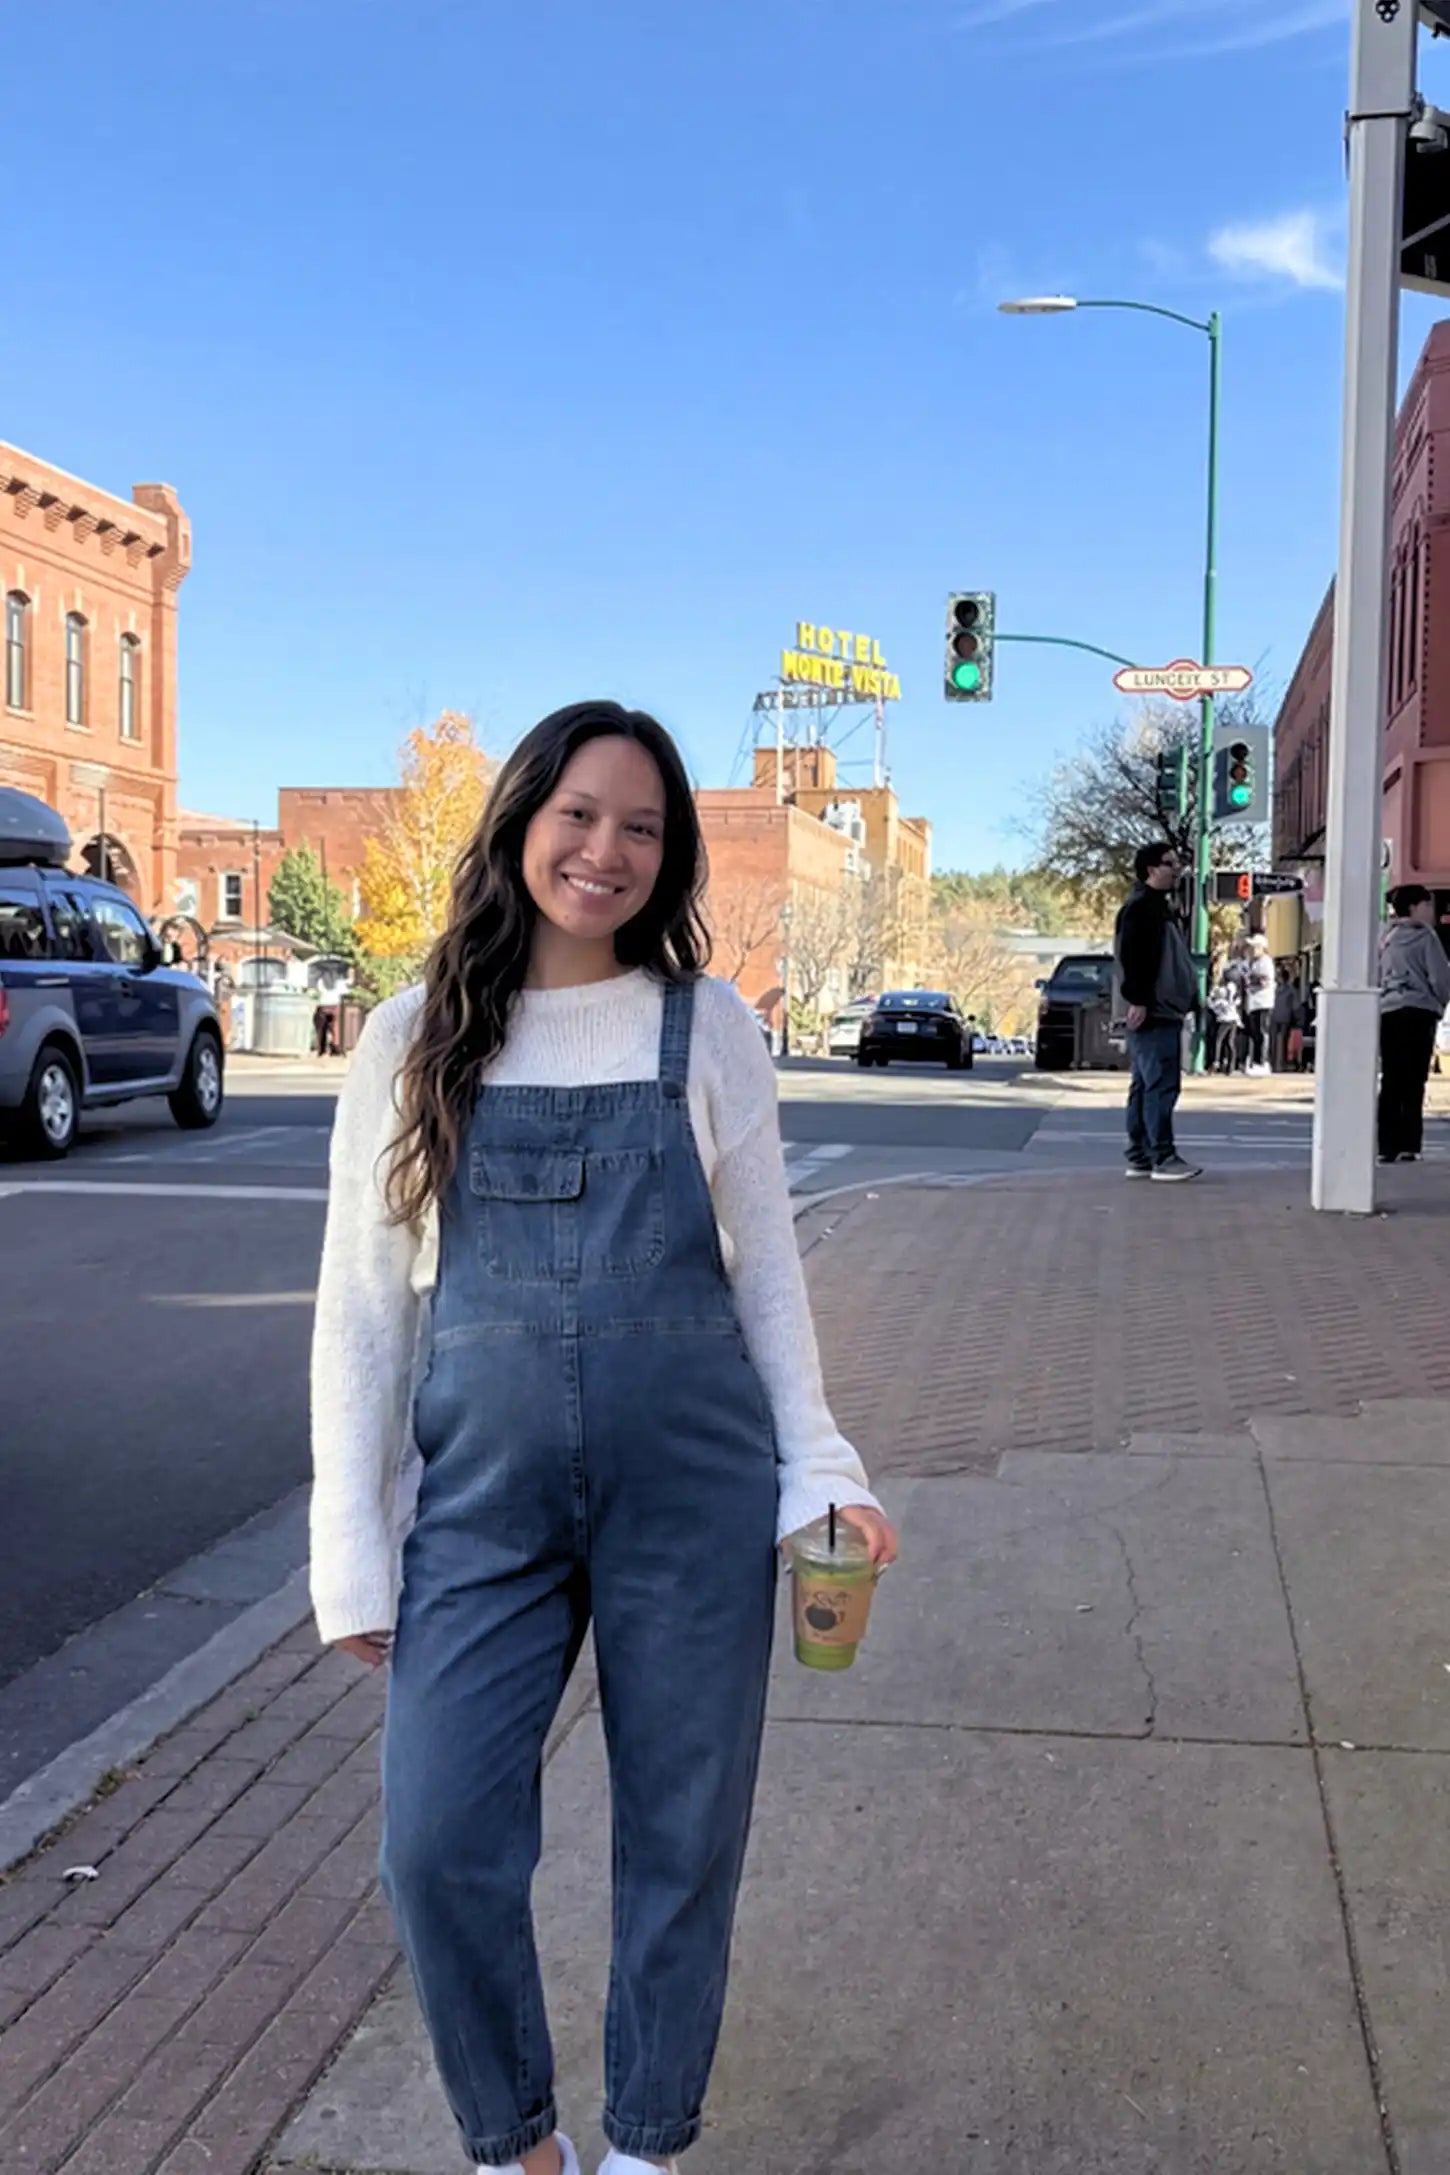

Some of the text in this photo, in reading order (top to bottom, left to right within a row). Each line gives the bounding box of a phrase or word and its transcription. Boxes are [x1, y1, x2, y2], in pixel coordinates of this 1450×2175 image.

[798, 622, 885, 665] HOTEL
[782, 650, 901, 700] MONTE VISTA
[1210, 671, 1230, 685] ST
